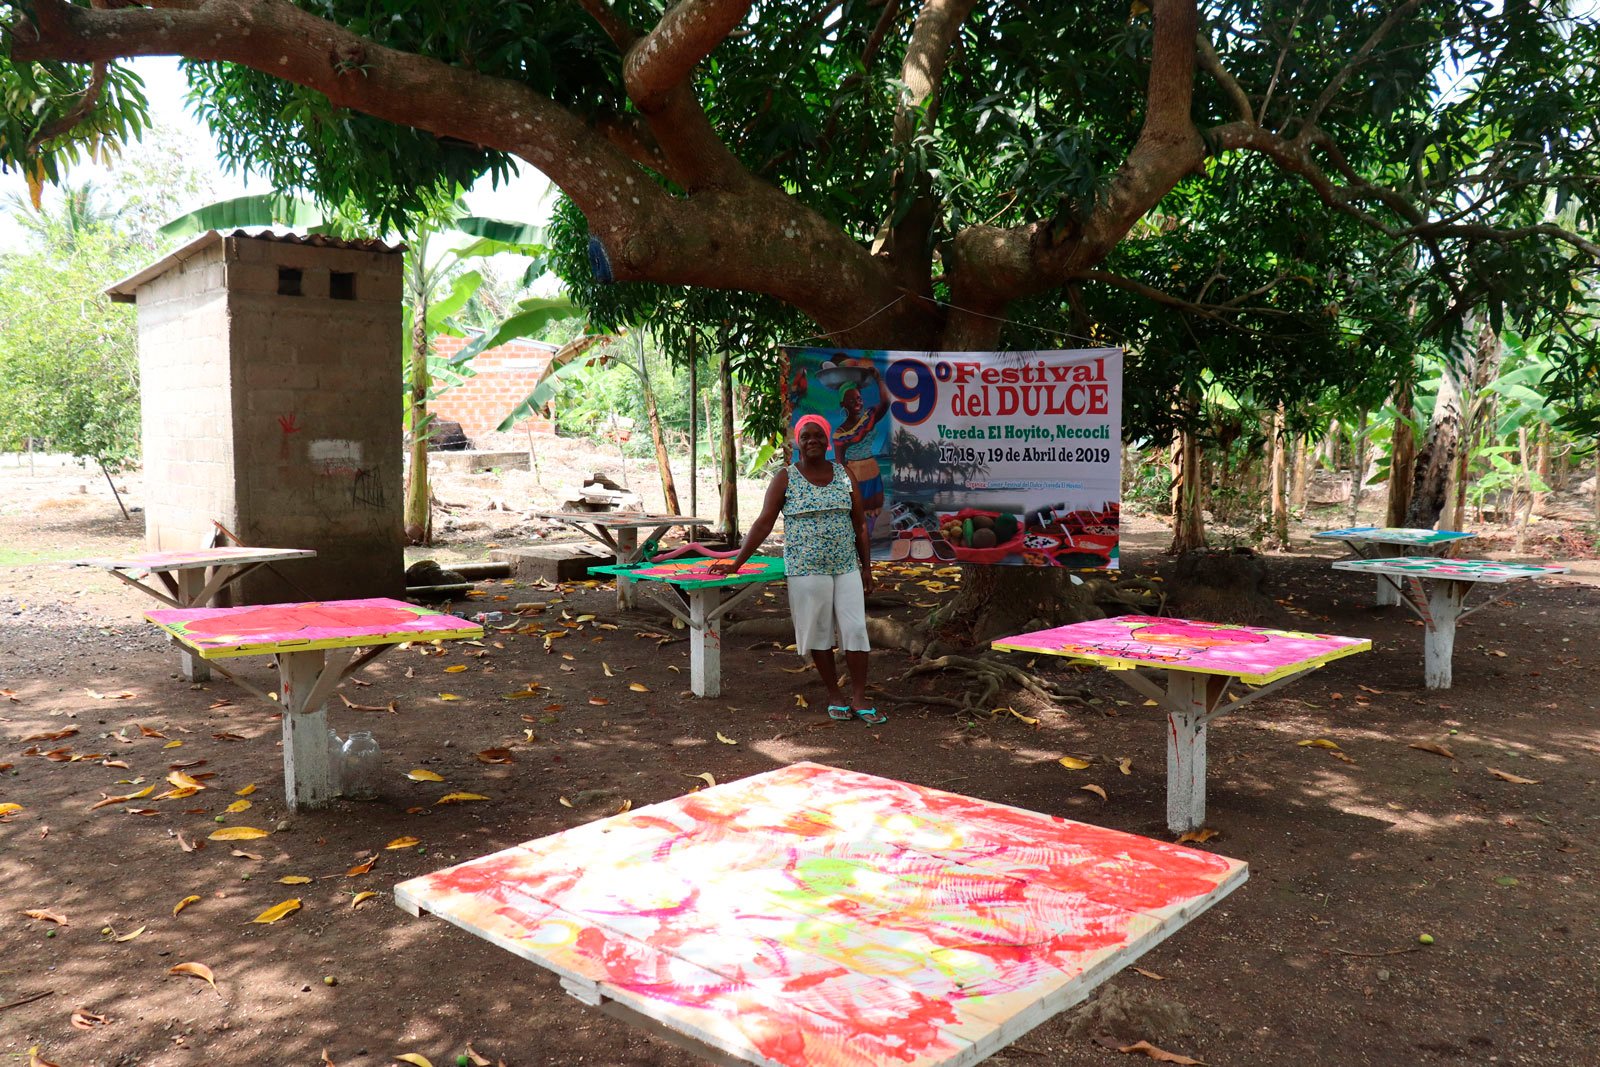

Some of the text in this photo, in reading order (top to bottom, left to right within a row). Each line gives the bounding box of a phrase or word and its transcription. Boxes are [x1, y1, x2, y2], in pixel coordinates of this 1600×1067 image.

[952, 358, 1108, 384] Festival
[951, 384, 1109, 417] del DULCE
[937, 424, 1110, 442] Vereda El Hoyito, Necoclí
[977, 450, 985, 465] y
[988, 447, 1003, 462] 19
[1006, 448, 1020, 462] de
[1022, 447, 1057, 462] Abril
[1058, 447, 1073, 462] de
[1075, 447, 1110, 463] 2019
